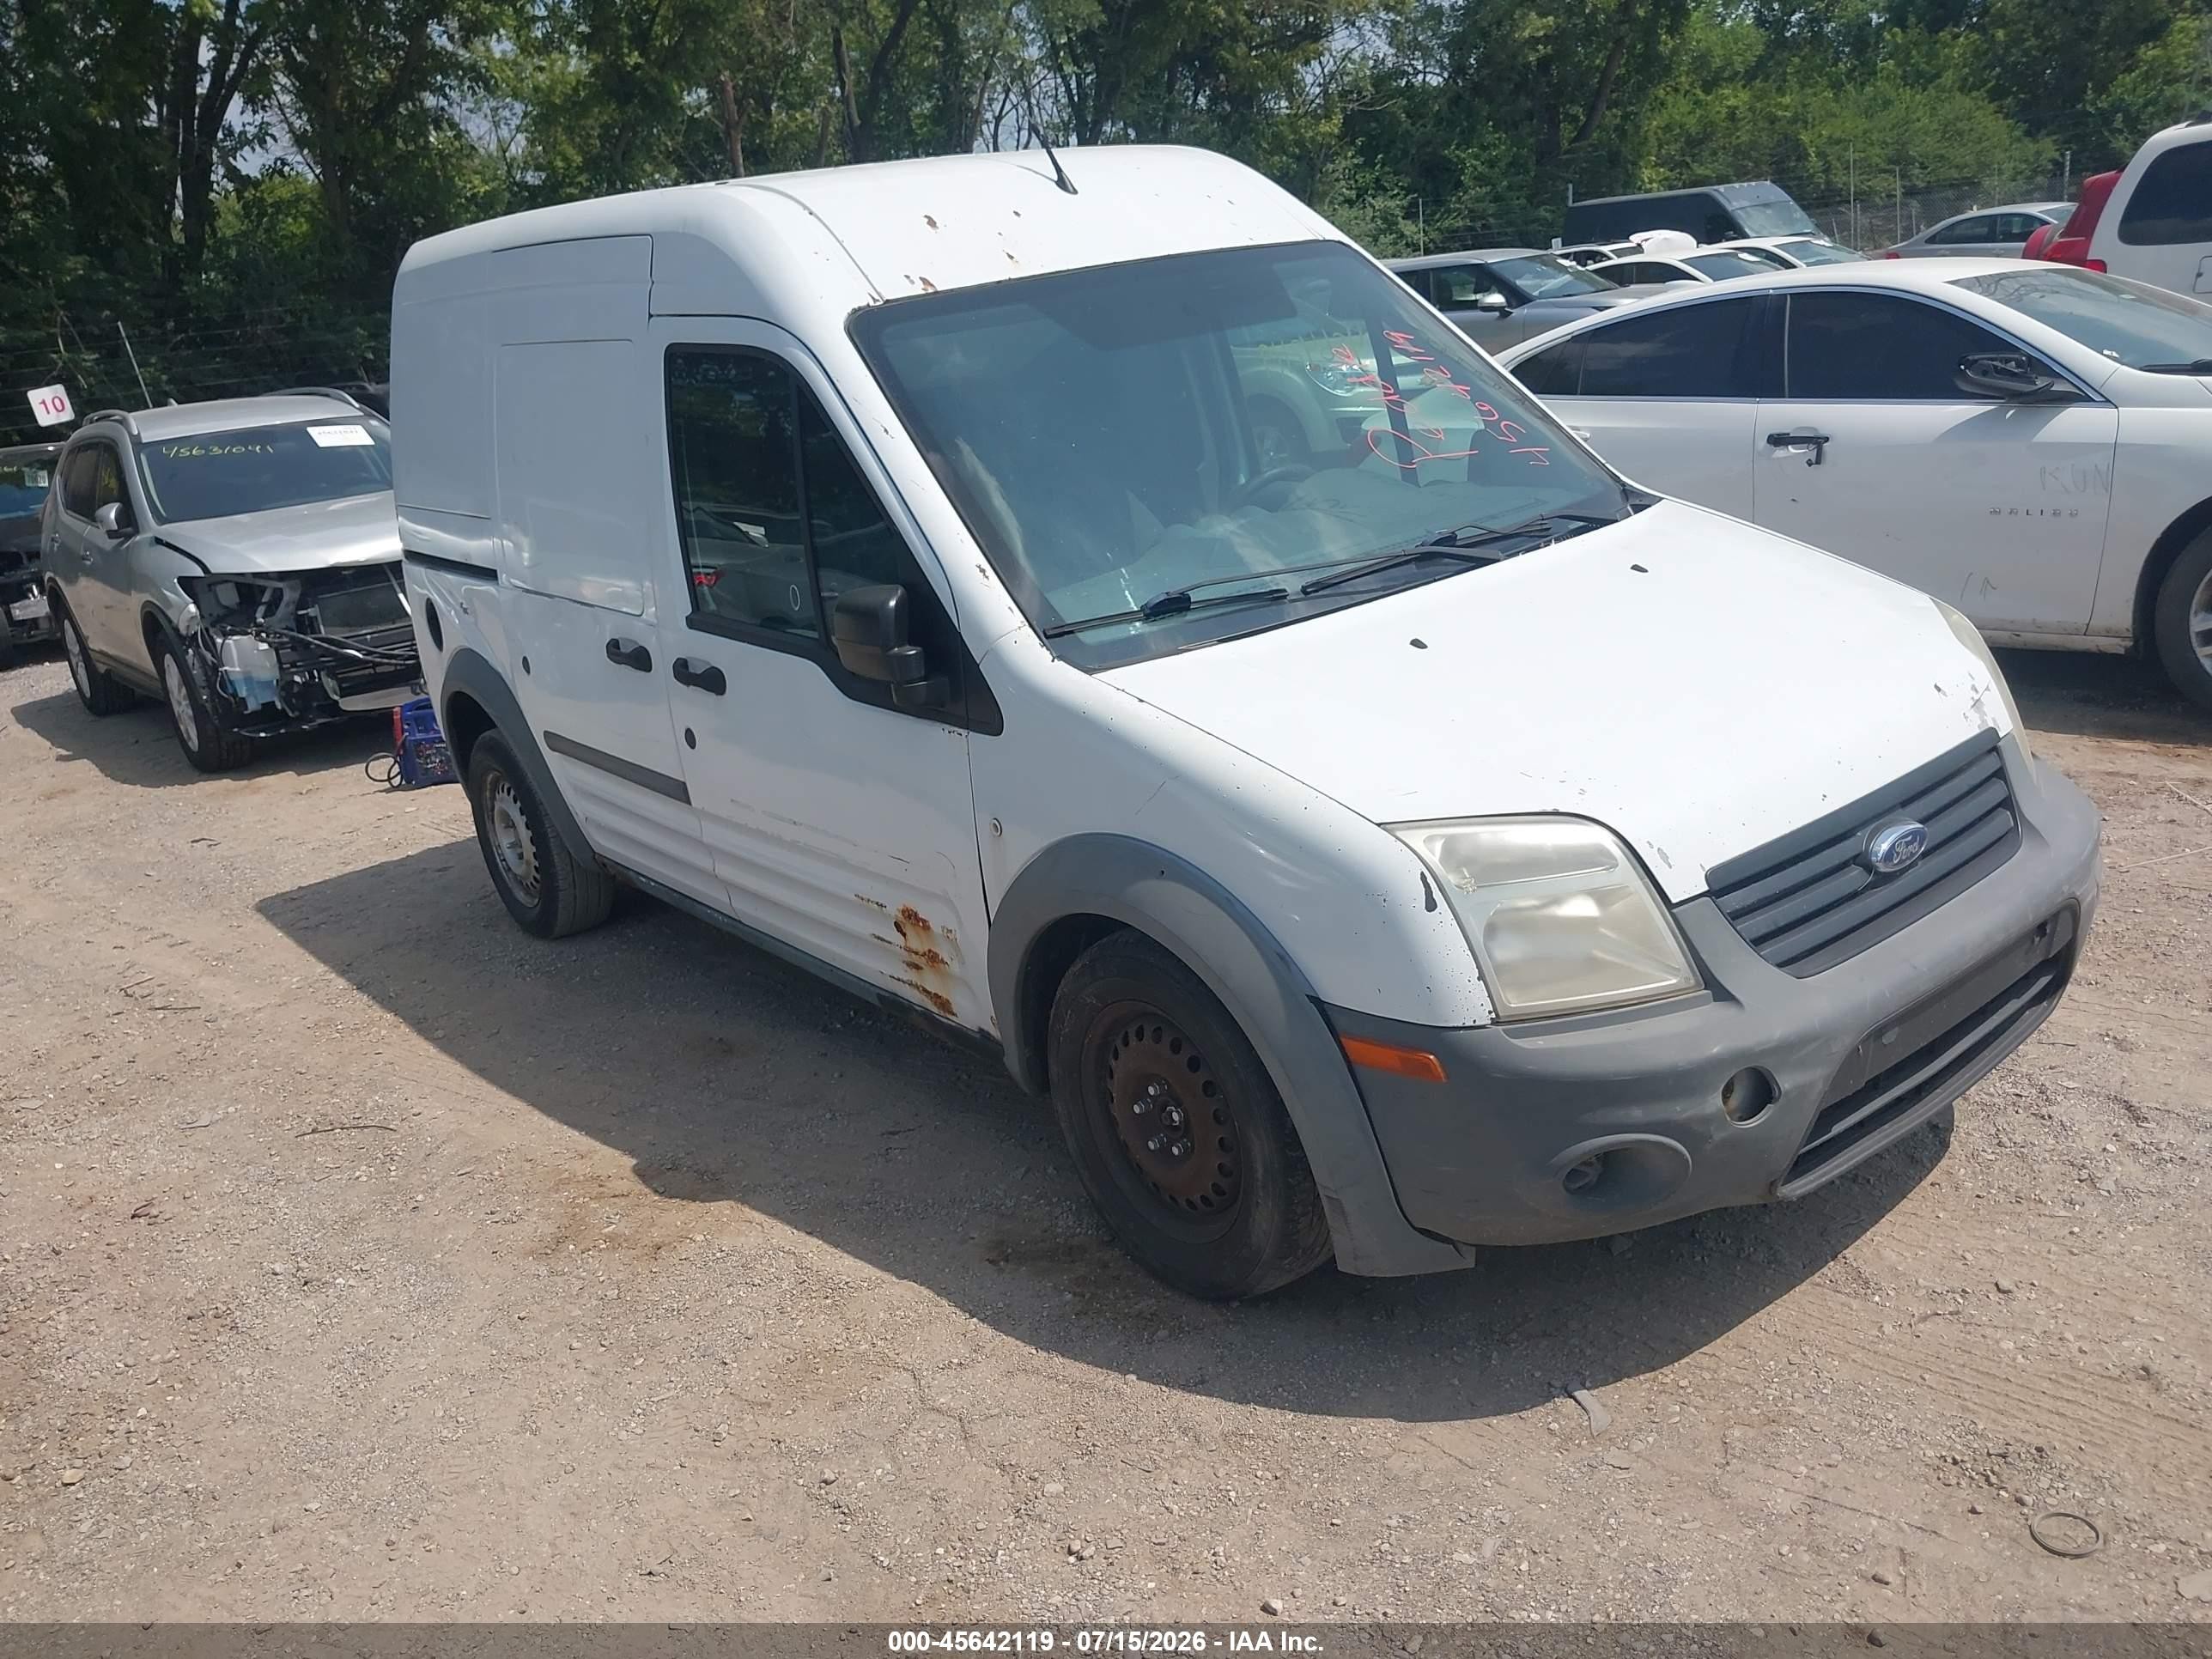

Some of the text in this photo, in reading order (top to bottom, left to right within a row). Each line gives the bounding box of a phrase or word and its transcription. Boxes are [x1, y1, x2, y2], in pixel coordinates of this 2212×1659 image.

[39, 395, 65, 415] 10
[1382, 330, 1551, 465] 45642119
[161, 444, 274, 458] 45631041
[1892, 835, 1920, 864] Ford
